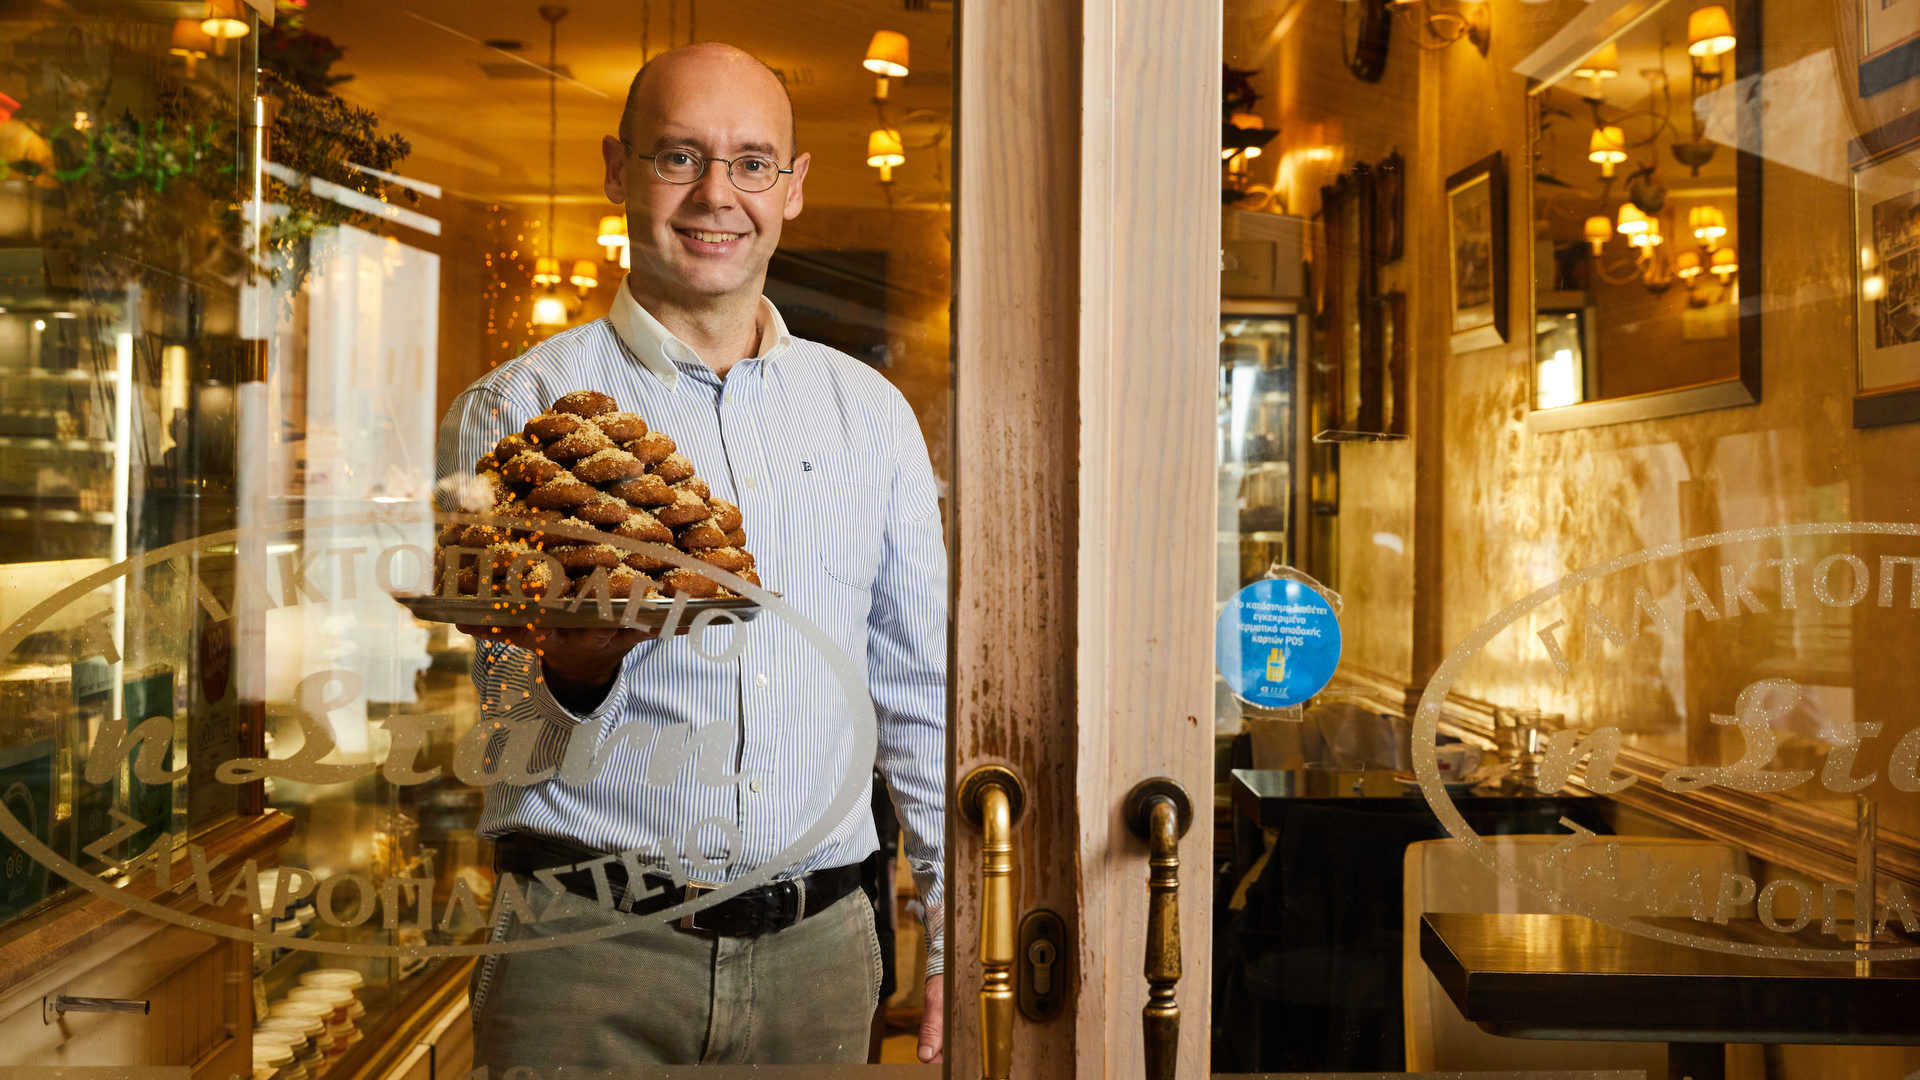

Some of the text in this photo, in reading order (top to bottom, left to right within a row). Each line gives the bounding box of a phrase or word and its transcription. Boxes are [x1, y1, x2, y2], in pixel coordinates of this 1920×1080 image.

[1246, 601, 1291, 612] κατάστημα
[1292, 603, 1327, 615] διαθέτει
[1253, 613, 1306, 624] εγκεκριμένο
[1280, 625, 1321, 638] αποδοχής
[1252, 635, 1304, 646] καρτών POS
